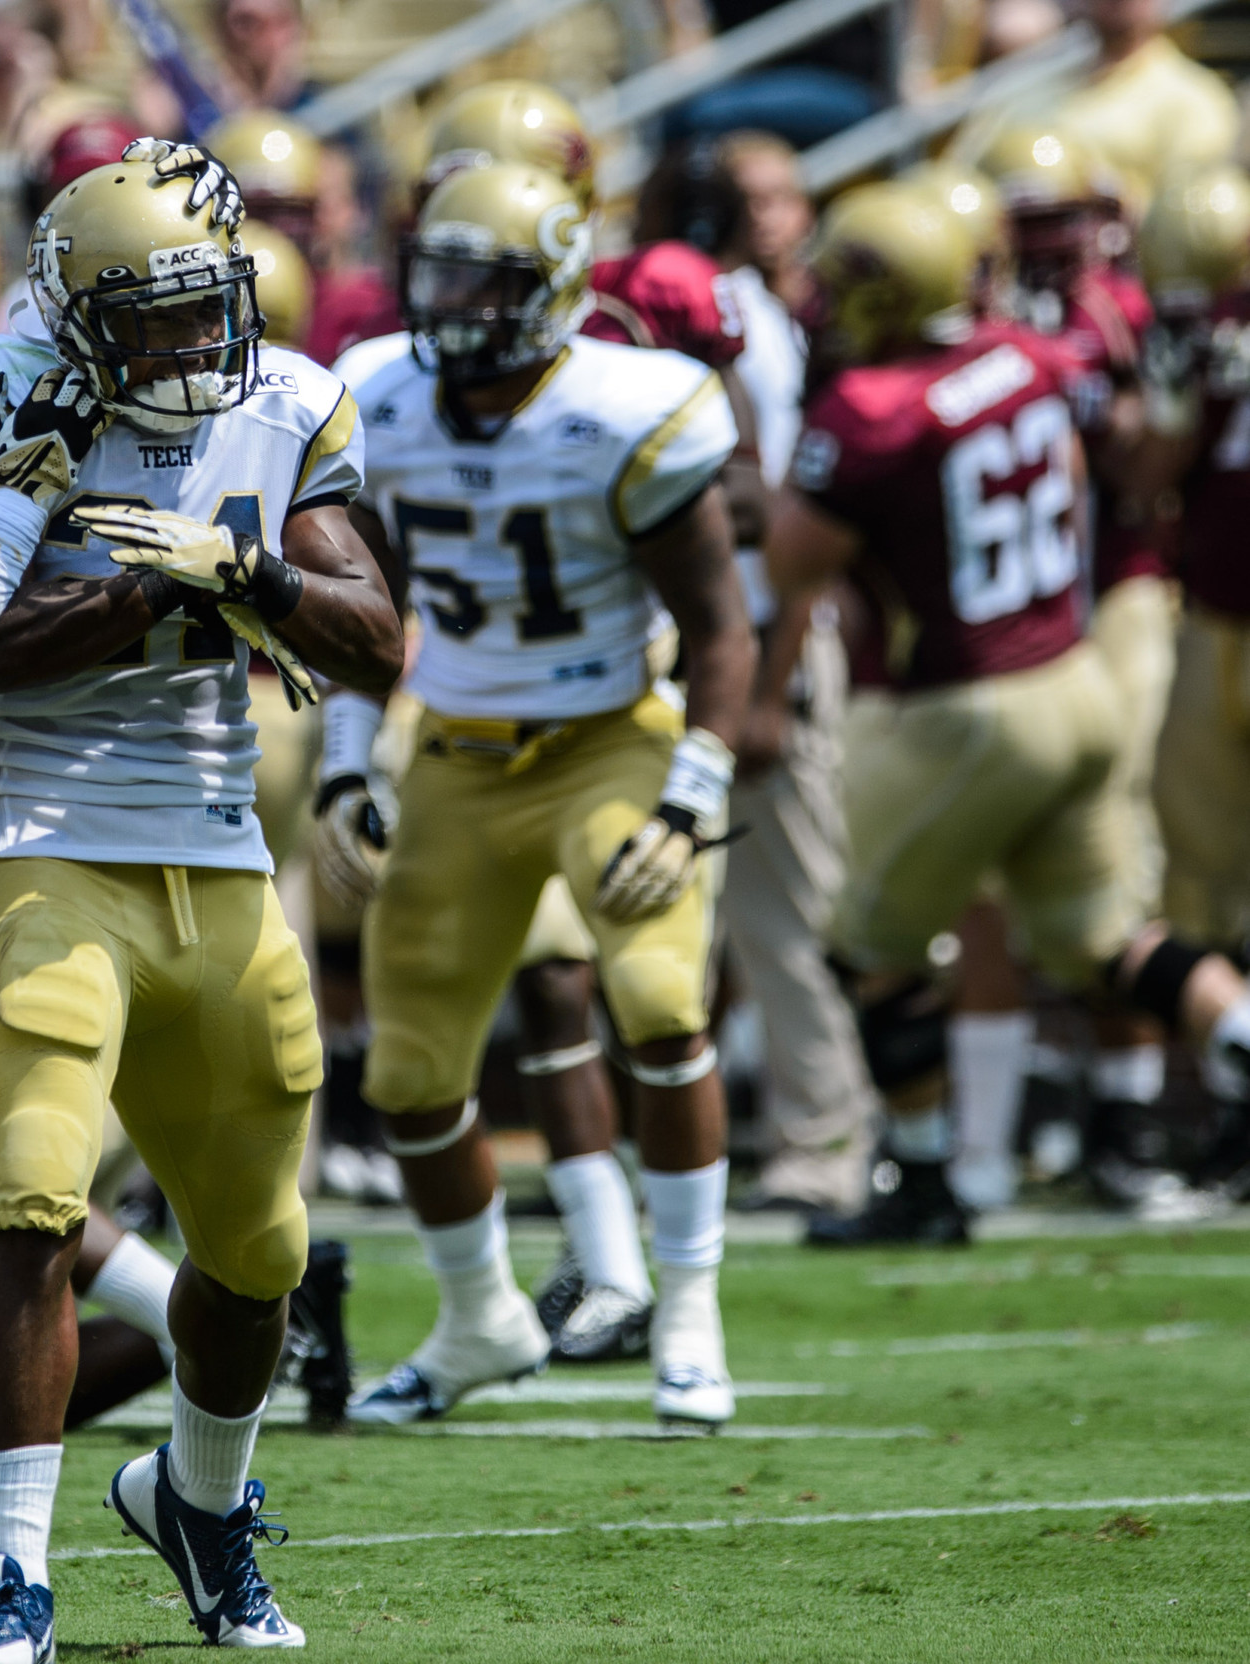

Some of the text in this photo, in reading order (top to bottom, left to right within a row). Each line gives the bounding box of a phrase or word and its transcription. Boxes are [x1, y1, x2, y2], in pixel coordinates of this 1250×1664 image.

[170, 248, 201, 266] ACC
[138, 445, 193, 469] TECH
[395, 496, 584, 642] 51
